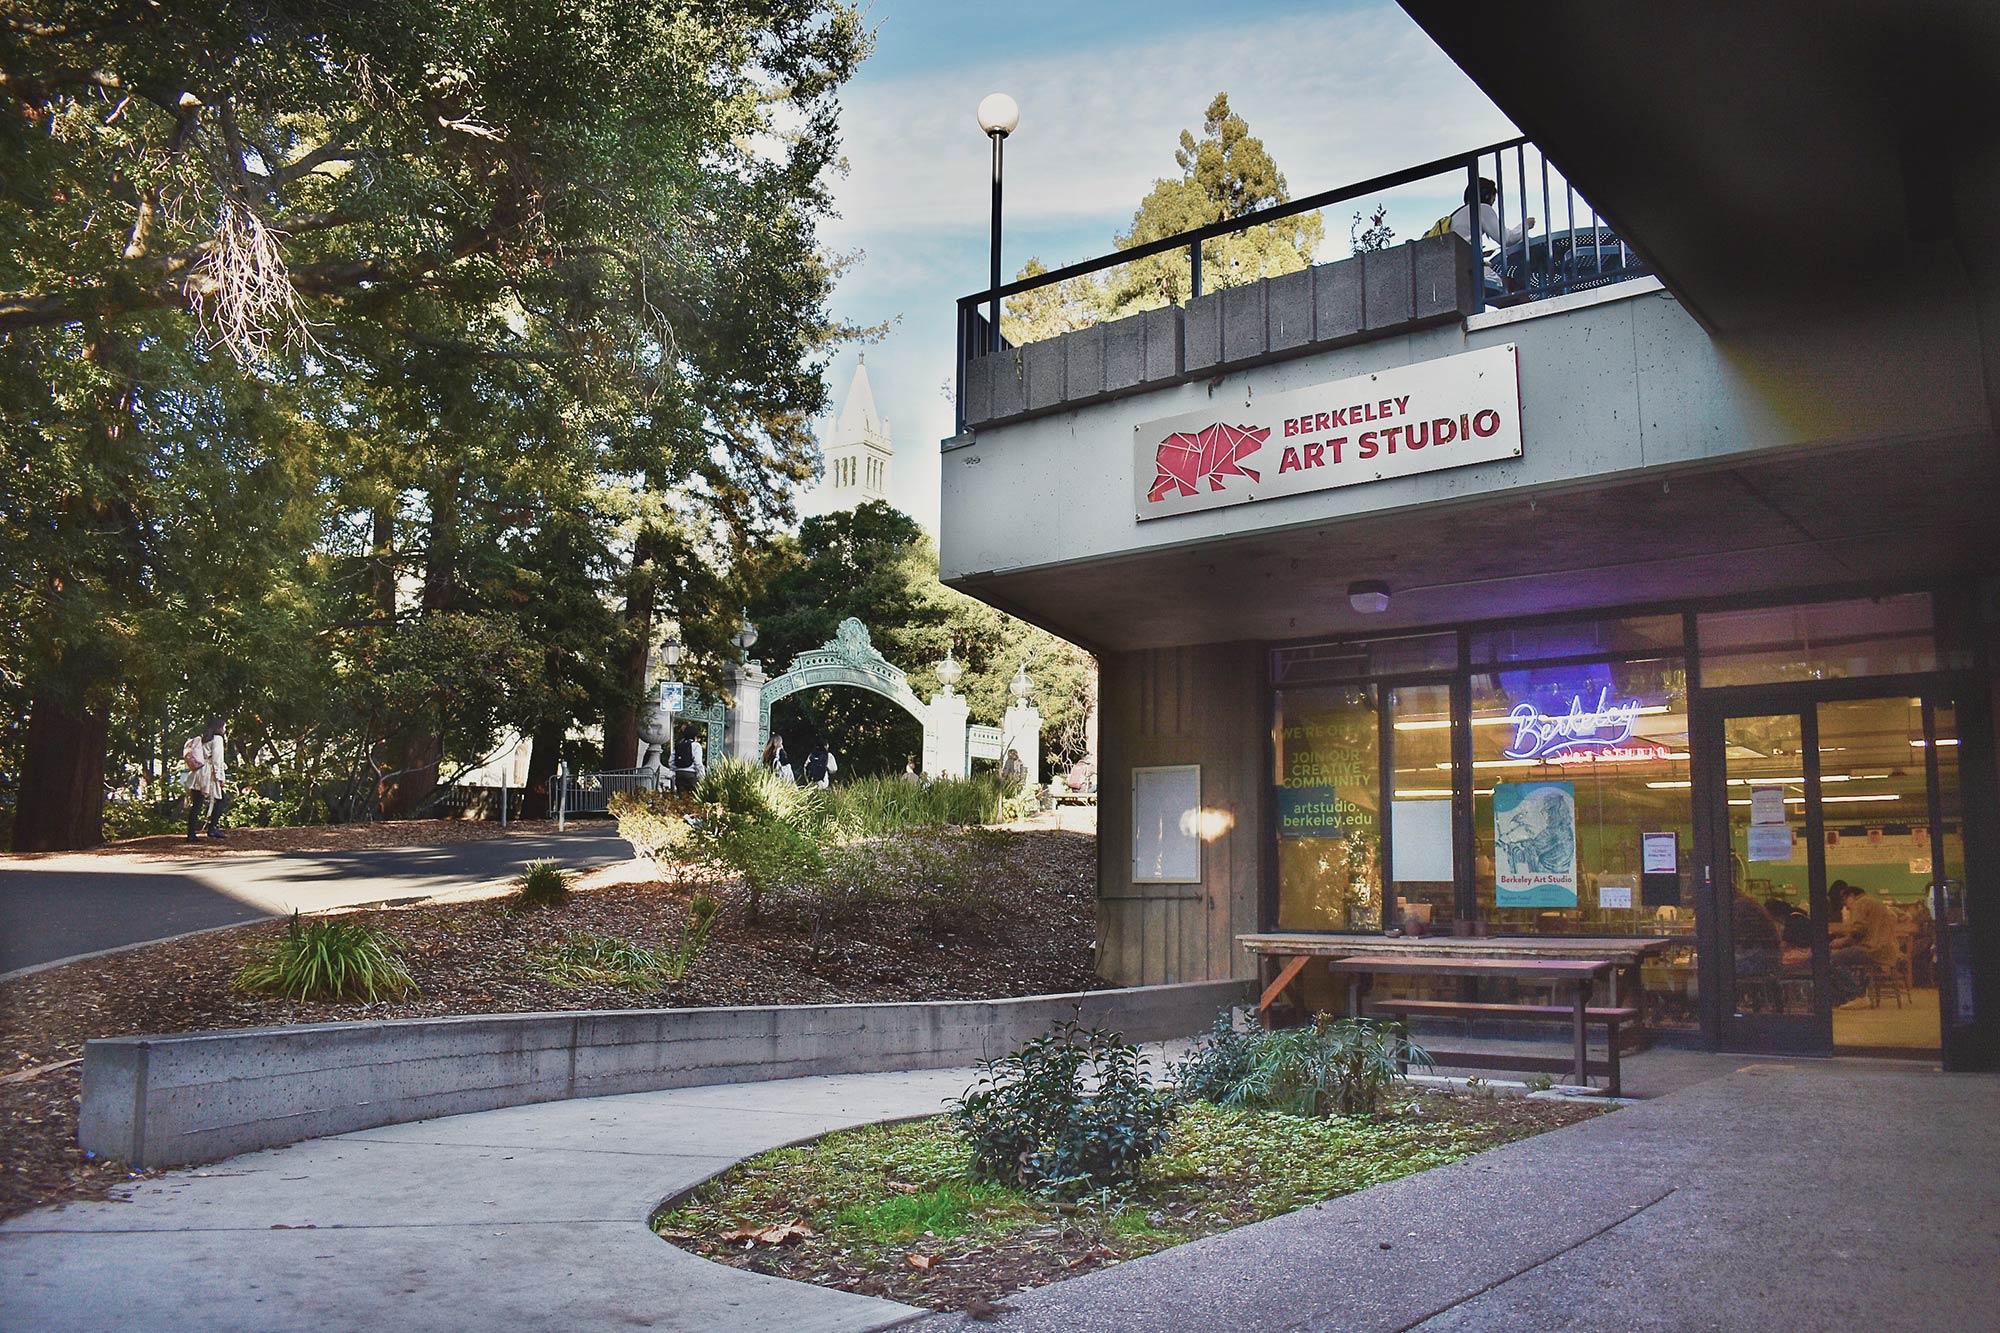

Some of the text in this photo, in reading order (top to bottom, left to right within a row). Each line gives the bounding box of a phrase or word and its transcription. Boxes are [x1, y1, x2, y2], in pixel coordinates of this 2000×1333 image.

[1284, 395, 1410, 437] BERKELEY
[1279, 409, 1501, 474] ART STUDIO
[1504, 687, 1638, 759] Berkeley
[1292, 750, 1360, 763] JOIN OUR
[1292, 761, 1362, 776] CREATIVE
[1283, 774, 1371, 789] COMMUNITY
[1294, 800, 1360, 814] artstudio.
[1283, 813, 1372, 828] berkeley.edu
[1501, 874, 1572, 885] Berkeley Art Studio
